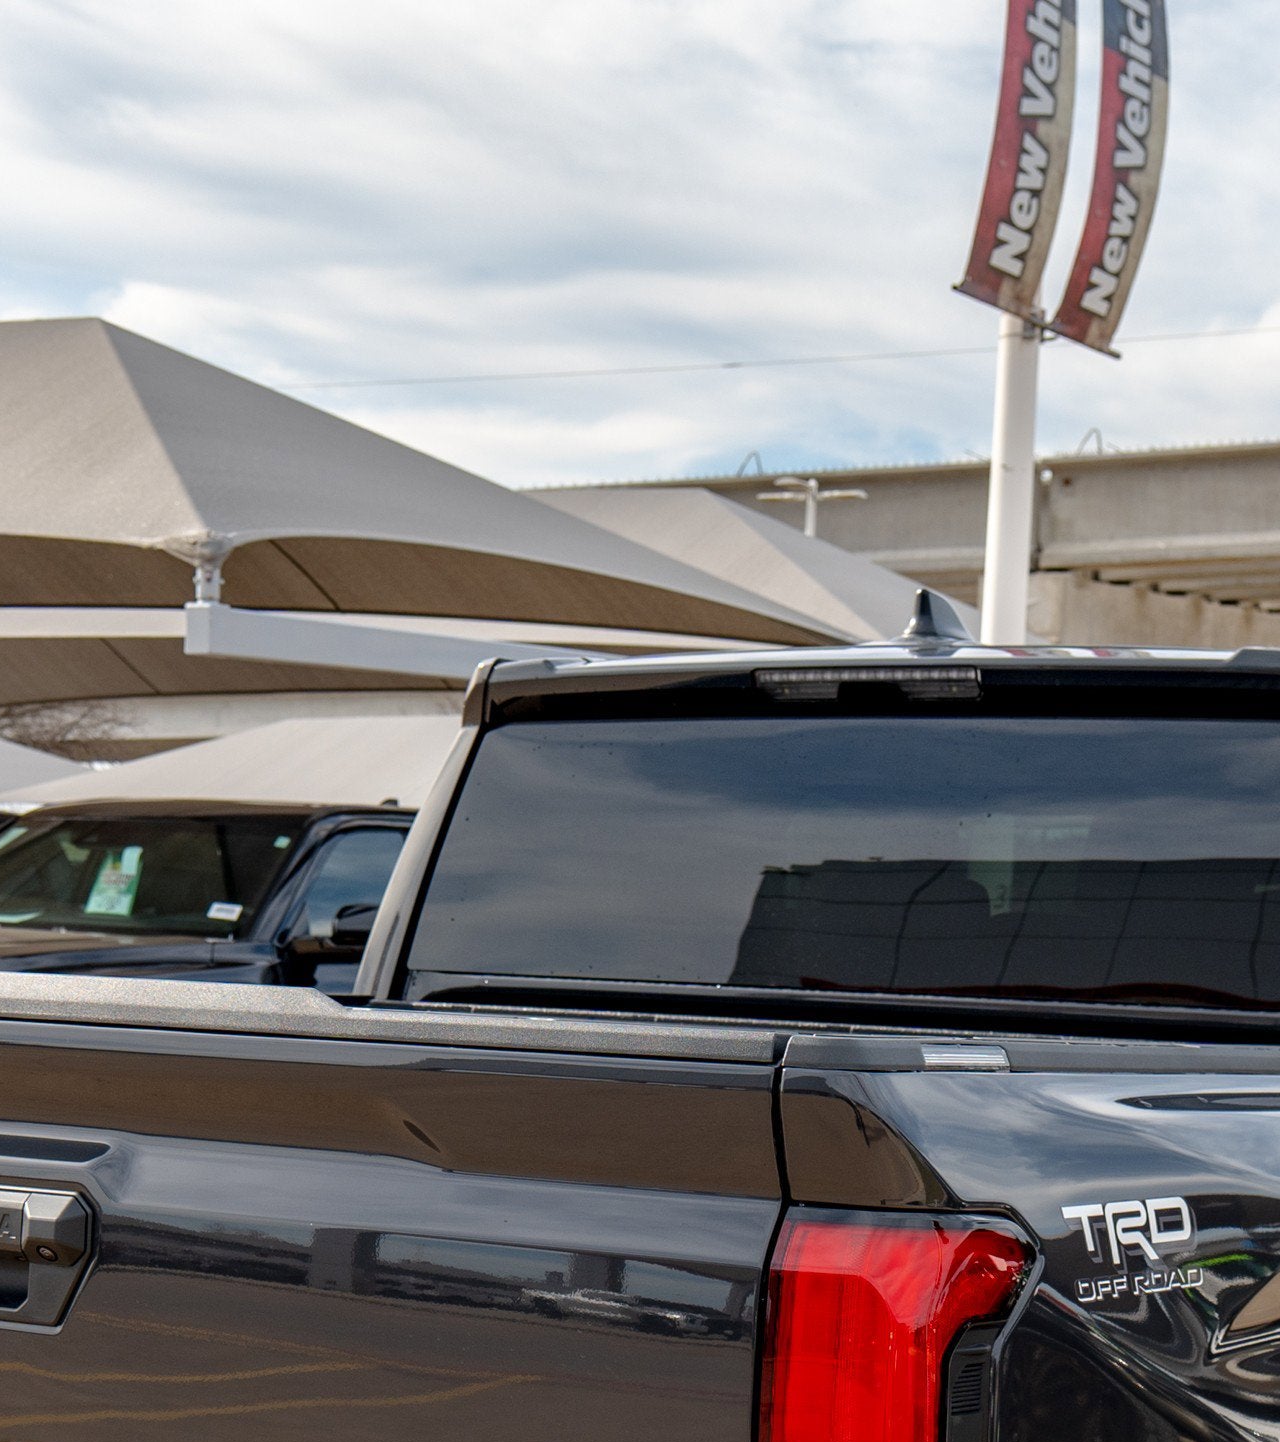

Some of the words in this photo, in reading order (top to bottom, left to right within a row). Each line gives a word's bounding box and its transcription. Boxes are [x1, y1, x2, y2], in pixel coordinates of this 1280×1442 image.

[989, 133, 1050, 278] New
[1020, 0, 1061, 117] Veh
[1080, 183, 1139, 317] New
[1061, 1196, 1193, 1265] TRD
[1075, 1273, 1128, 1303] OFF
[1132, 1267, 1204, 1296] ROAD
